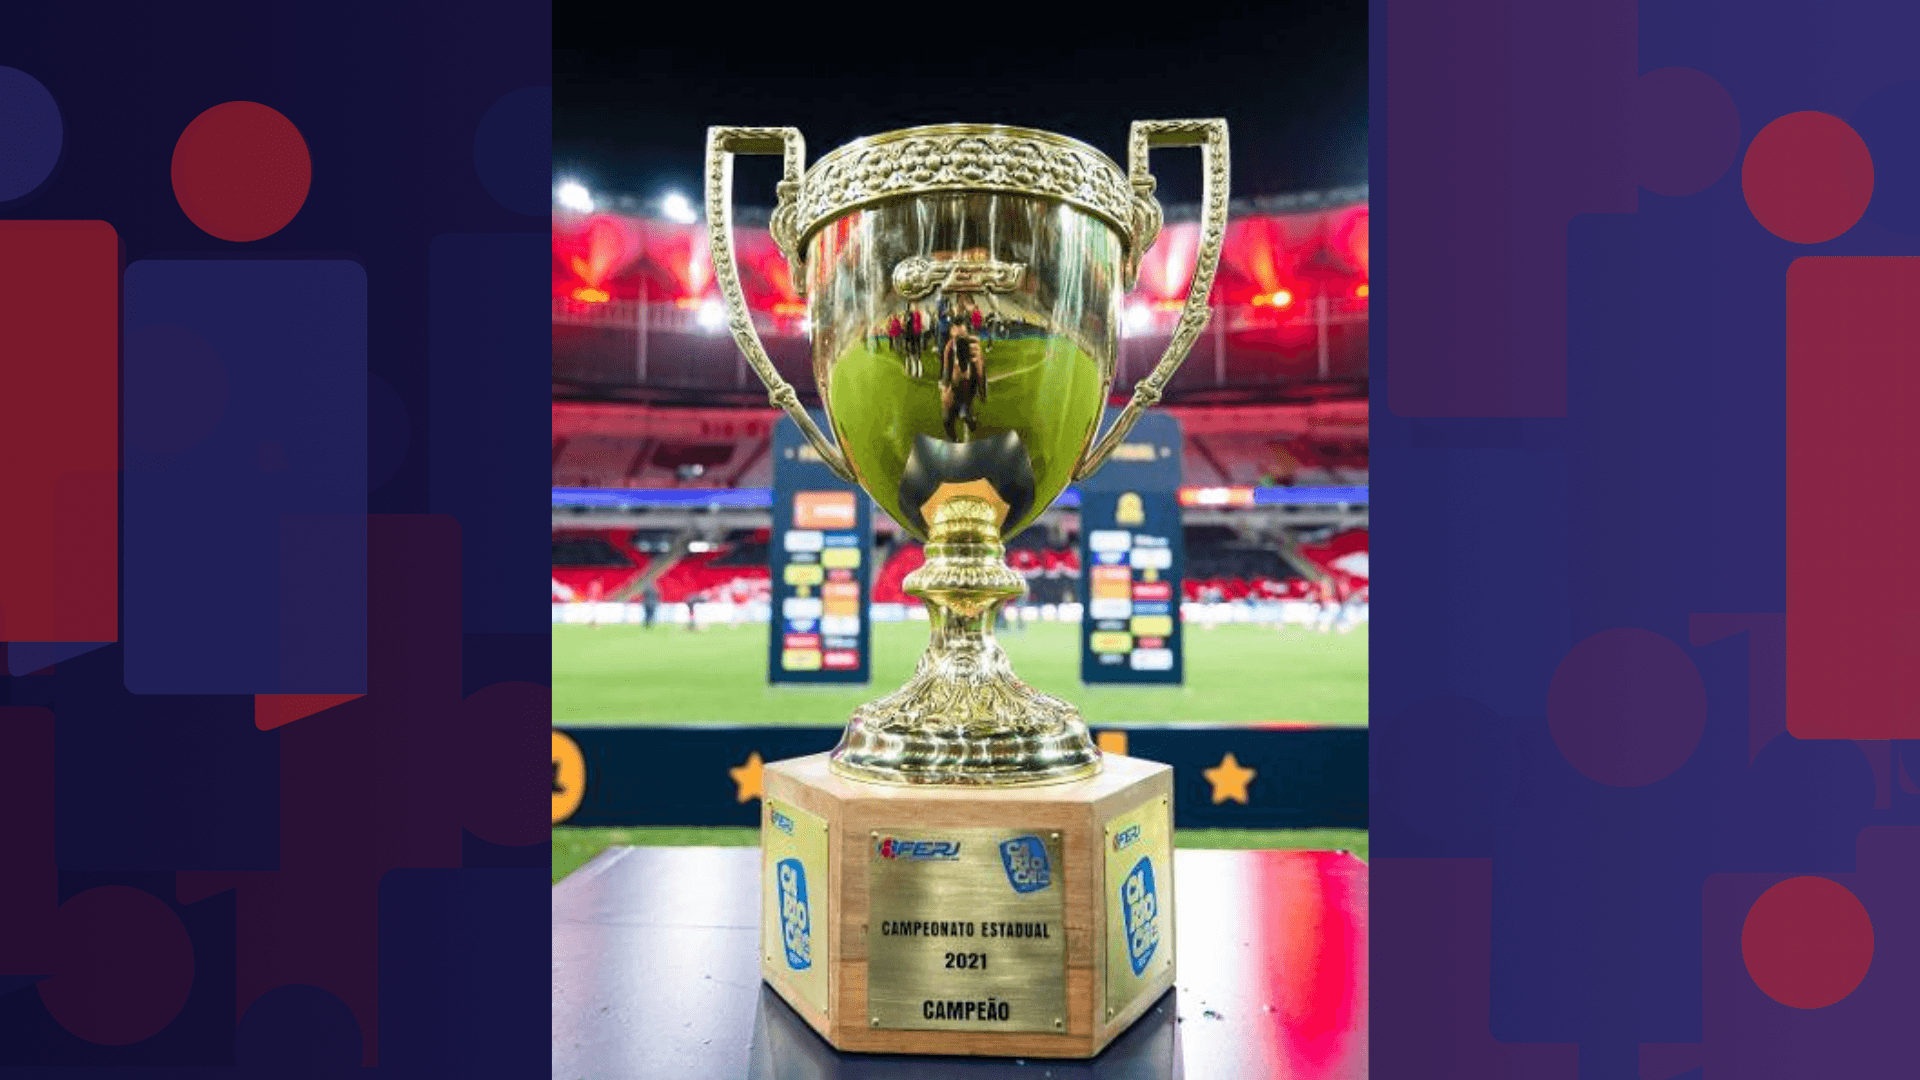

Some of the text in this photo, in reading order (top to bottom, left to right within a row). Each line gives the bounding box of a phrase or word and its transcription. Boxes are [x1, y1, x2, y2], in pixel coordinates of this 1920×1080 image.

[895, 840, 961, 857] FERJ
[881, 920, 1051, 939] CAMPEONATO ESTADUAL
[944, 952, 988, 971] 2021
[922, 996, 1011, 1022] CAMPEÃO
